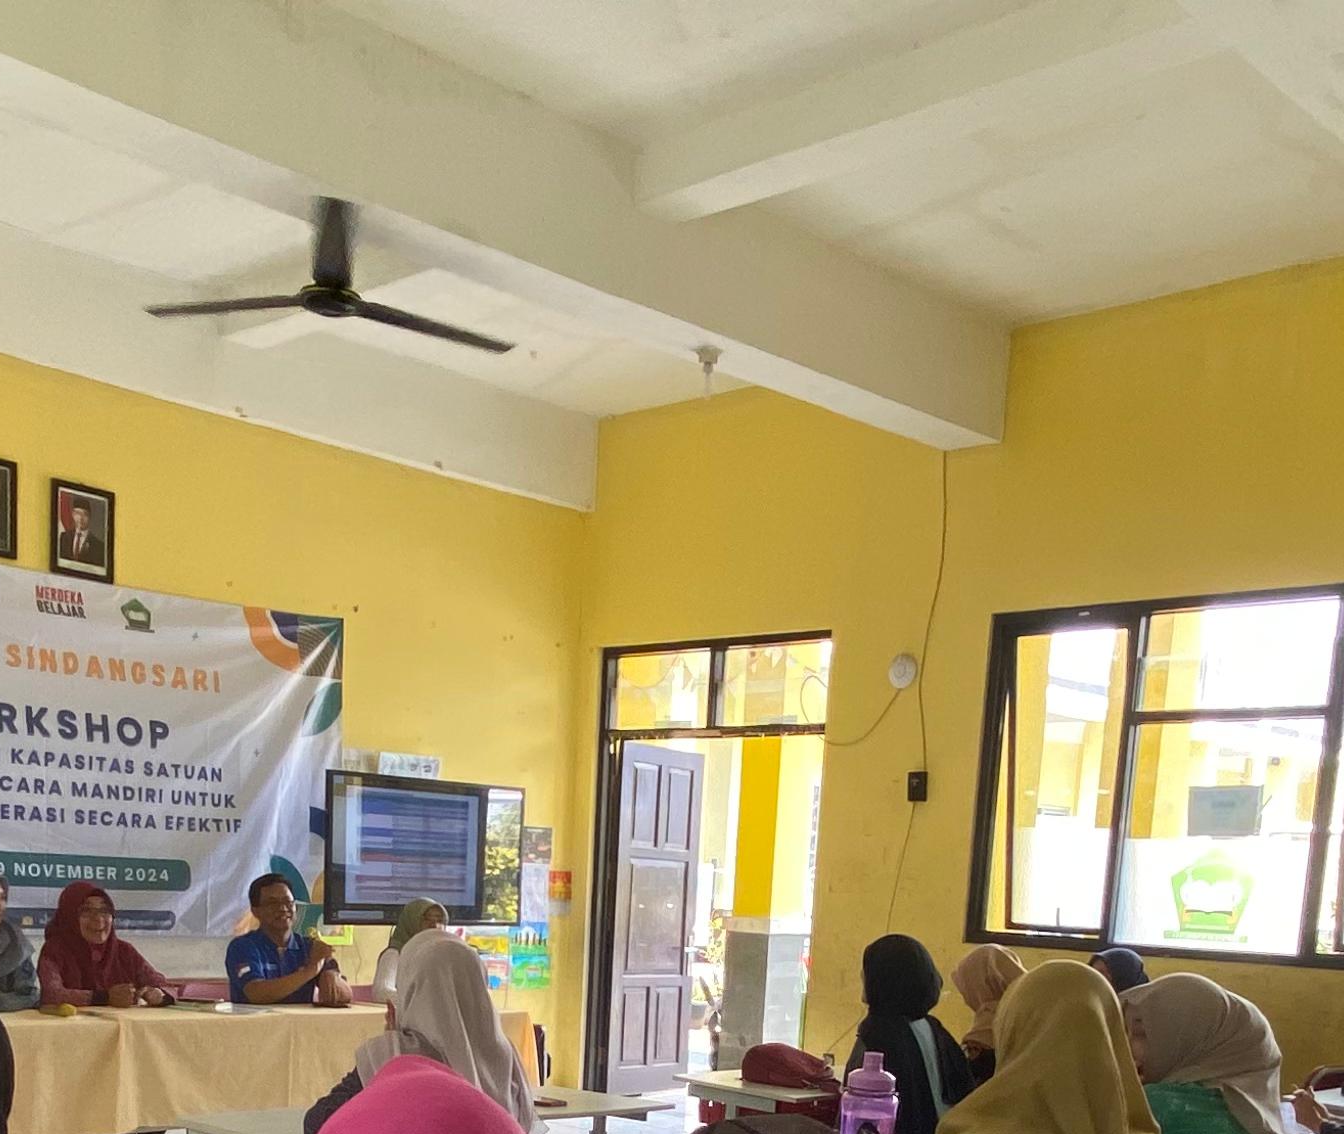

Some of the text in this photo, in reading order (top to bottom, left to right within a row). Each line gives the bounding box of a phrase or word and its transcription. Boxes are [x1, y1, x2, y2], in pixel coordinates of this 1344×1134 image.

[35, 585, 84, 606] MERDEKA
[36, 599, 87, 619] BELAJAR
[6, 643, 222, 694] SINDANGSARI
[10, 748, 135, 775] KAPASITAS
[143, 760, 223, 783] SATUAN
[71, 780, 164, 805] MANDIRI
[171, 789, 236, 809] UNTUK
[74, 808, 157, 831] SECARA
[164, 814, 242, 834] EFEKTIF
[13, 861, 118, 881] NOVEMBER
[123, 867, 170, 882] 2024
